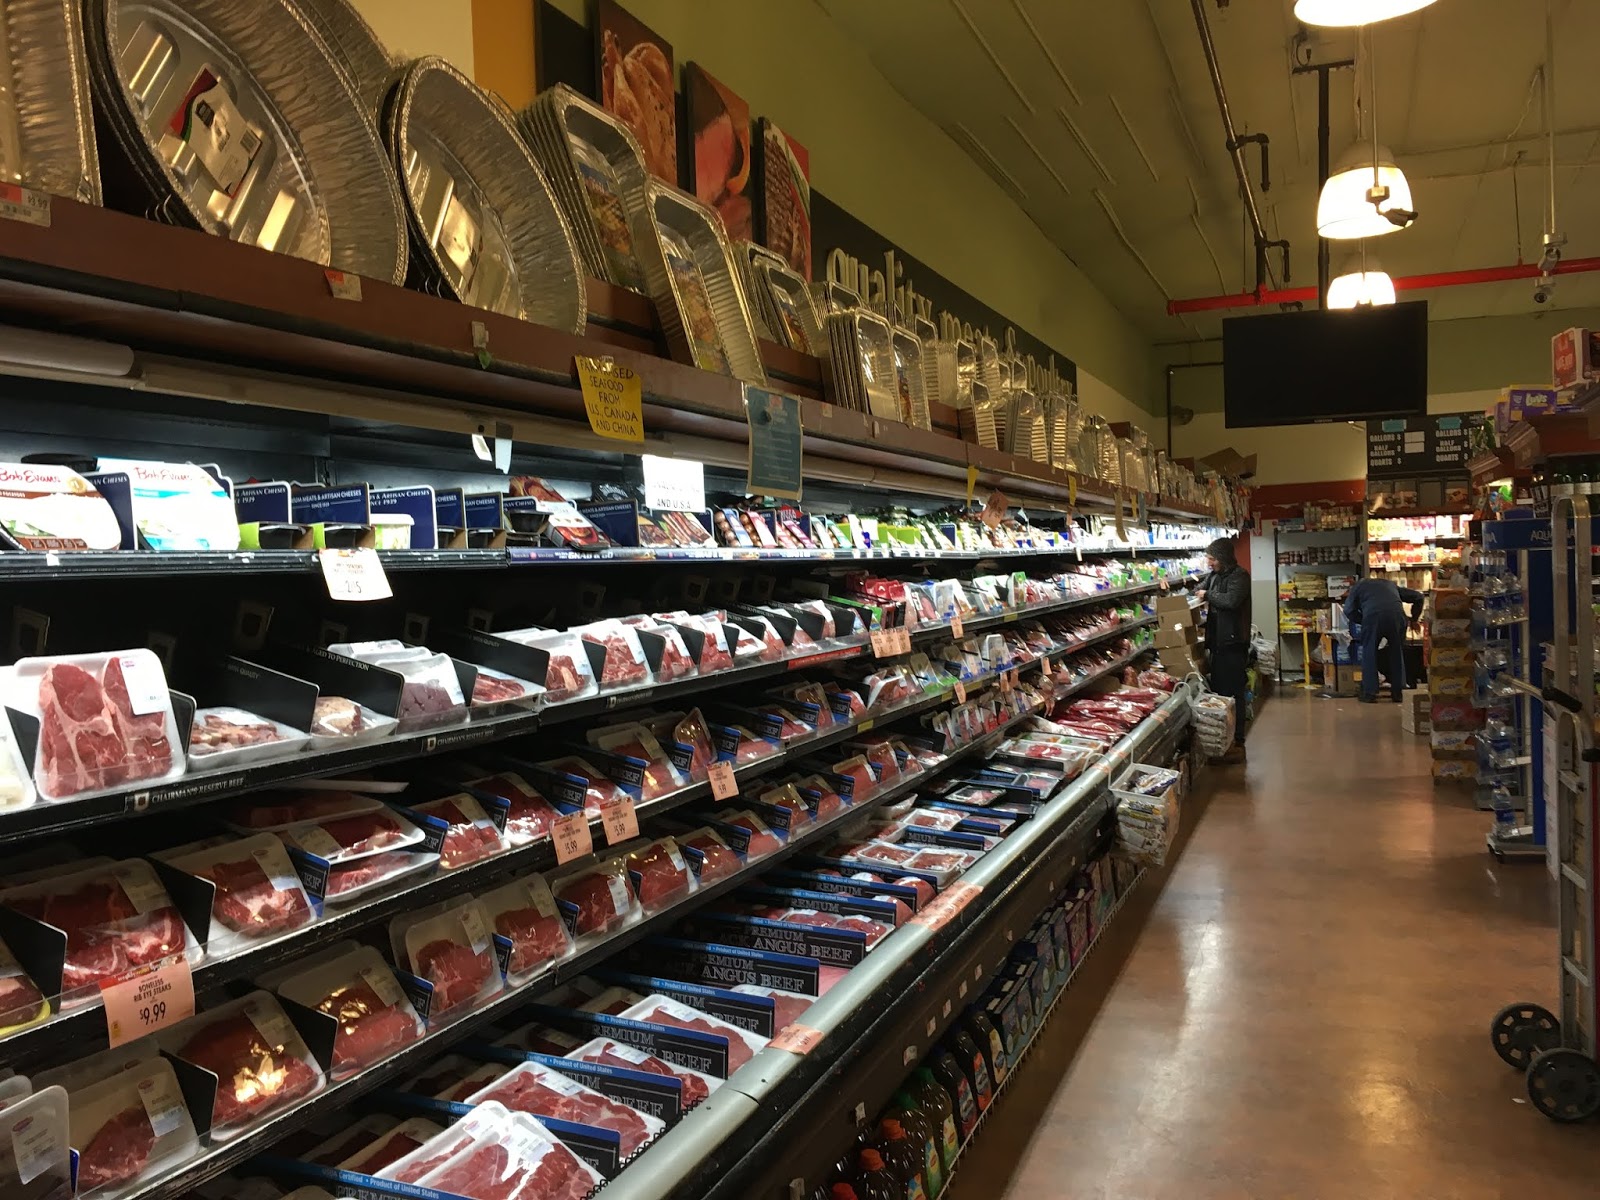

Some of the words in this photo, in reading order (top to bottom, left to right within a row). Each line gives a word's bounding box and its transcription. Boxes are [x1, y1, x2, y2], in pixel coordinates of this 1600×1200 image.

[590, 375, 624, 393] SEAFOOD
[598, 391, 620, 405] FROM
[604, 406, 638, 422] CANADA
[596, 419, 610, 432] AND
[612, 422, 636, 436] CHINA
[1436, 429, 1462, 438] GALLONS
[1370, 434, 1396, 442] GALLONS
[1370, 458, 1393, 466] QUARTS
[1436, 453, 1459, 462] QUARTS
[321, 492, 340, 500] ARTISAN
[341, 490, 362, 498] CHEESES
[438, 494, 456, 502] CHEESES
[657, 498, 671, 508] AND
[336, 656, 370, 672] PERFECTION
[152, 787, 197, 804] CHAIRMAN'S
[199, 781, 227, 794] RESERVE
[228, 778, 244, 788] BEEF
[753, 938, 806, 955] ANGUS
[810, 944, 853, 960] BEEF
[138, 978, 164, 992] BONELESS
[702, 964, 756, 984] ANGUS
[761, 974, 805, 992] BEEF
[134, 994, 142, 1002] RIB
[153, 983, 172, 996] STEAKS
[139, 1001, 166, 1025] $9.99
[610, 1017, 630, 1026] Product
[637, 1021, 652, 1029] United
[652, 1024, 666, 1032] States
[553, 1058, 572, 1067] Product
[580, 1062, 596, 1071] United
[597, 1066, 613, 1074] States
[338, 1171, 363, 1183] Certified
[370, 1178, 392, 1188] Product
[401, 1183, 420, 1194] United
[421, 1188, 439, 1199] States
